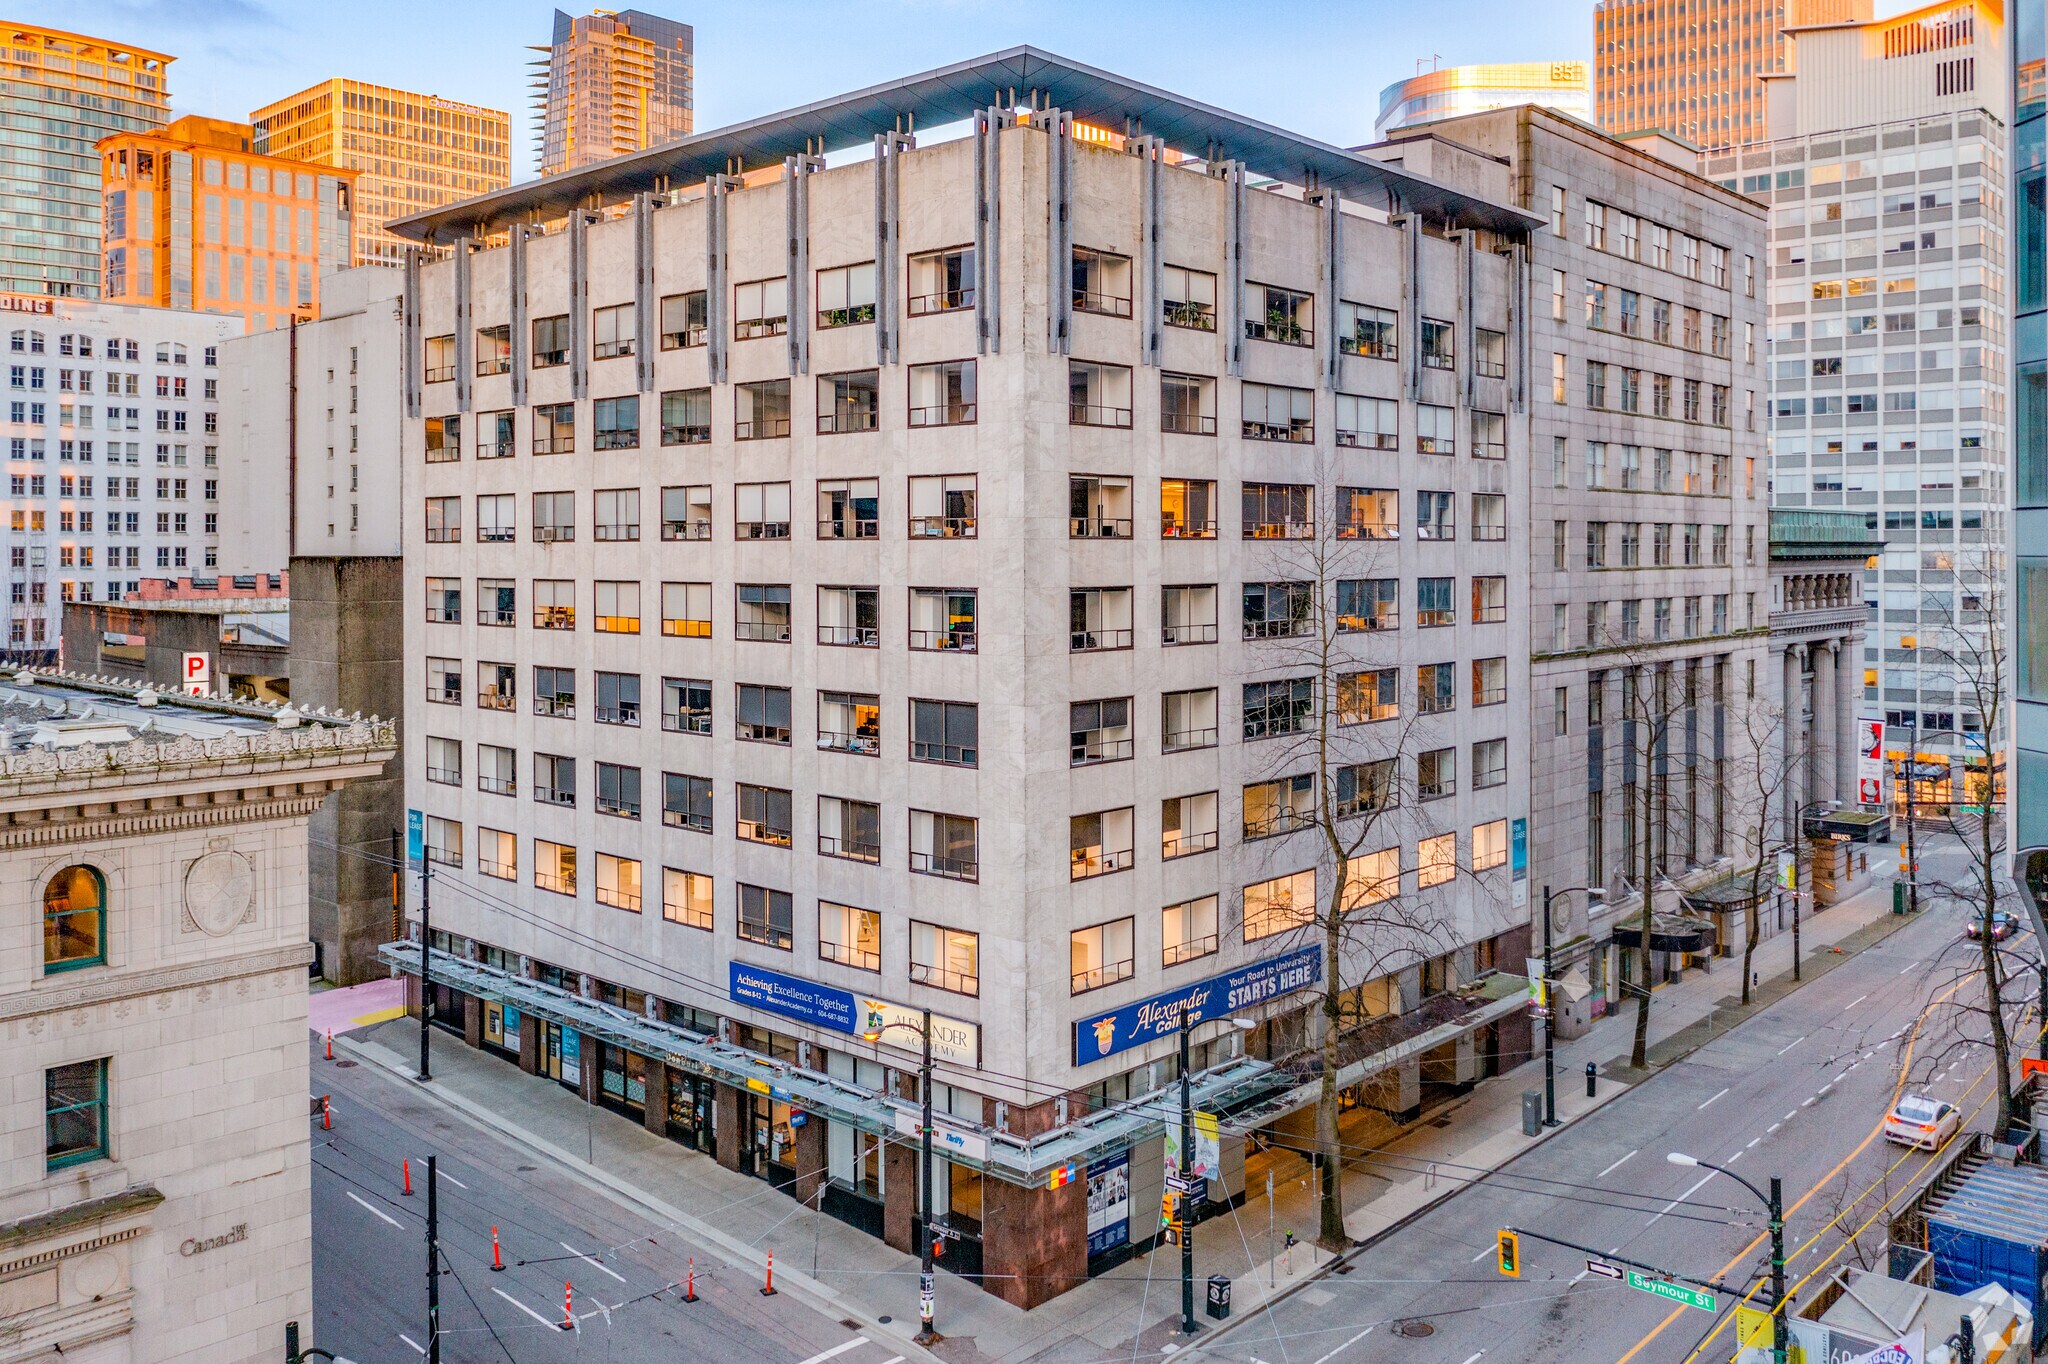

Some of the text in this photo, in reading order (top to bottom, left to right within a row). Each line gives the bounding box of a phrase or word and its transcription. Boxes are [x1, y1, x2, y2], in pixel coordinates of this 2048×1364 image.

[409, 813, 418, 821] FOR
[409, 821, 423, 831] LEASE
[1228, 954, 1311, 988] Your Road to University
[1228, 964, 1311, 1009] STARTS HERE
[736, 986, 849, 1024] Grades 8-12 AlexanderAcademy.ca 604-687-8832
[737, 973, 849, 1013] Achieving Excellence Together
[1128, 987, 1210, 1039] Alexander
[1155, 1010, 1202, 1034] Collge
[894, 1014, 967, 1047] ALEXNDER
[904, 1036, 956, 1057] ACEMY
[946, 1133, 965, 1148] Thrifty
[180, 1226, 248, 1257] Canada
[1634, 1274, 1710, 1307] Seymour St
